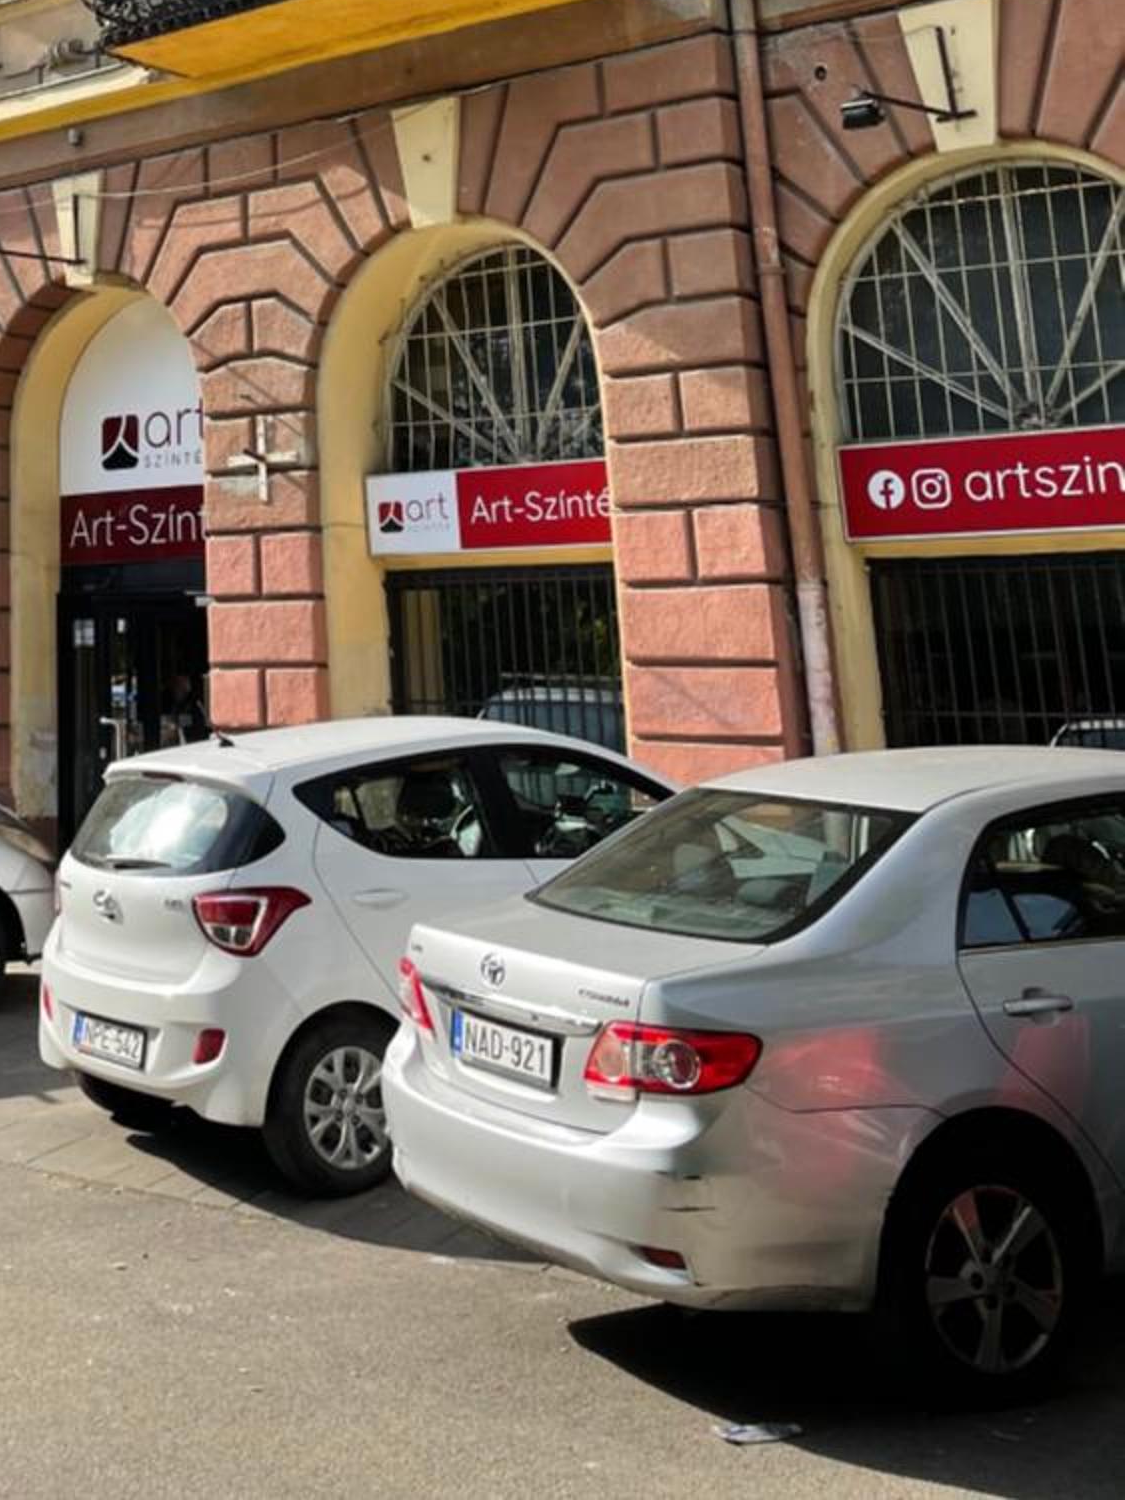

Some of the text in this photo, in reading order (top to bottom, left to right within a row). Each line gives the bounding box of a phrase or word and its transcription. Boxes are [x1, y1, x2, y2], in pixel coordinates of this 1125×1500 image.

[964, 455, 1125, 501] artszin
[405, 491, 449, 522] art
[464, 1020, 546, 1074] NAD-921
